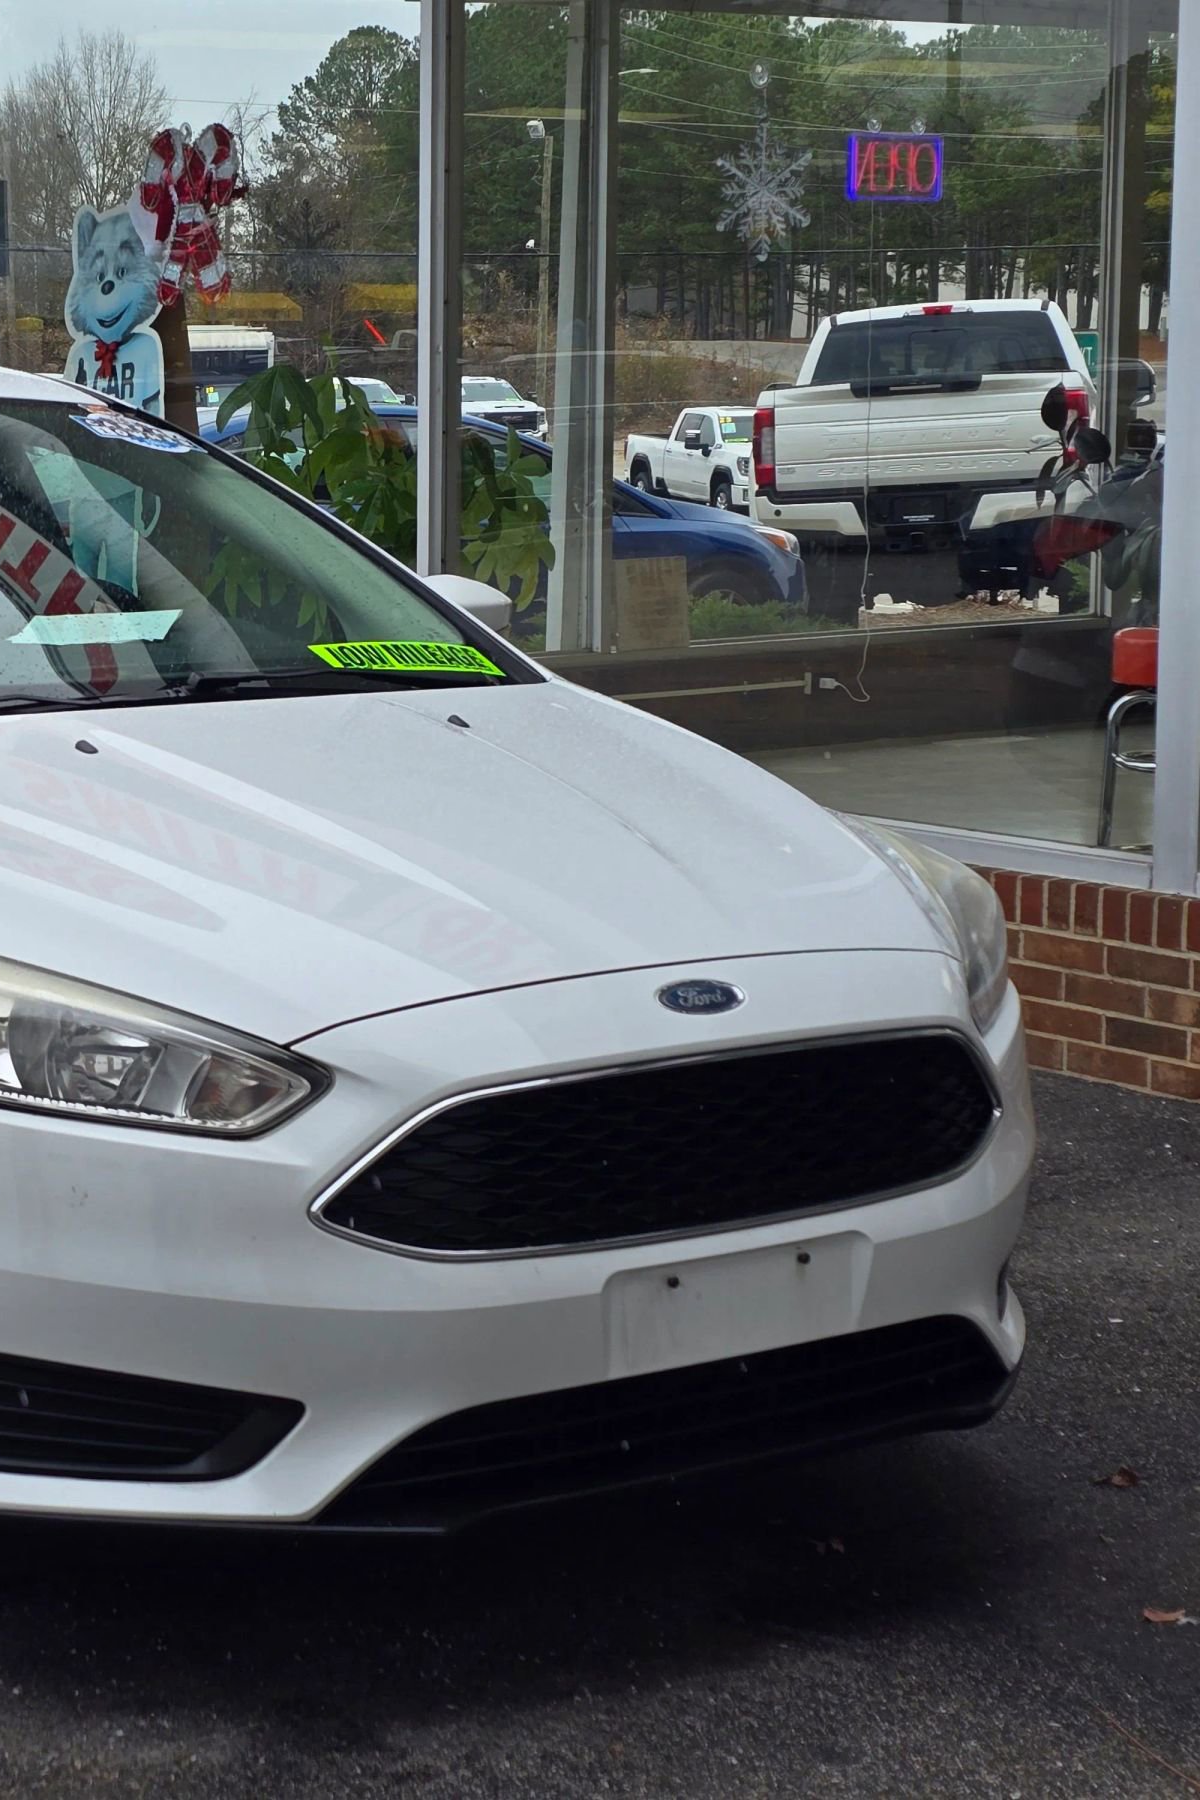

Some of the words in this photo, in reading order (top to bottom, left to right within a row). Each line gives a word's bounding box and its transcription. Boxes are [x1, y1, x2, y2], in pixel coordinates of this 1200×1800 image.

[816, 461, 927, 477] SUPER
[934, 457, 1020, 472] DUTY
[324, 645, 388, 668] LOW
[383, 643, 486, 669] MILEAGE
[676, 987, 727, 1008] Ford
